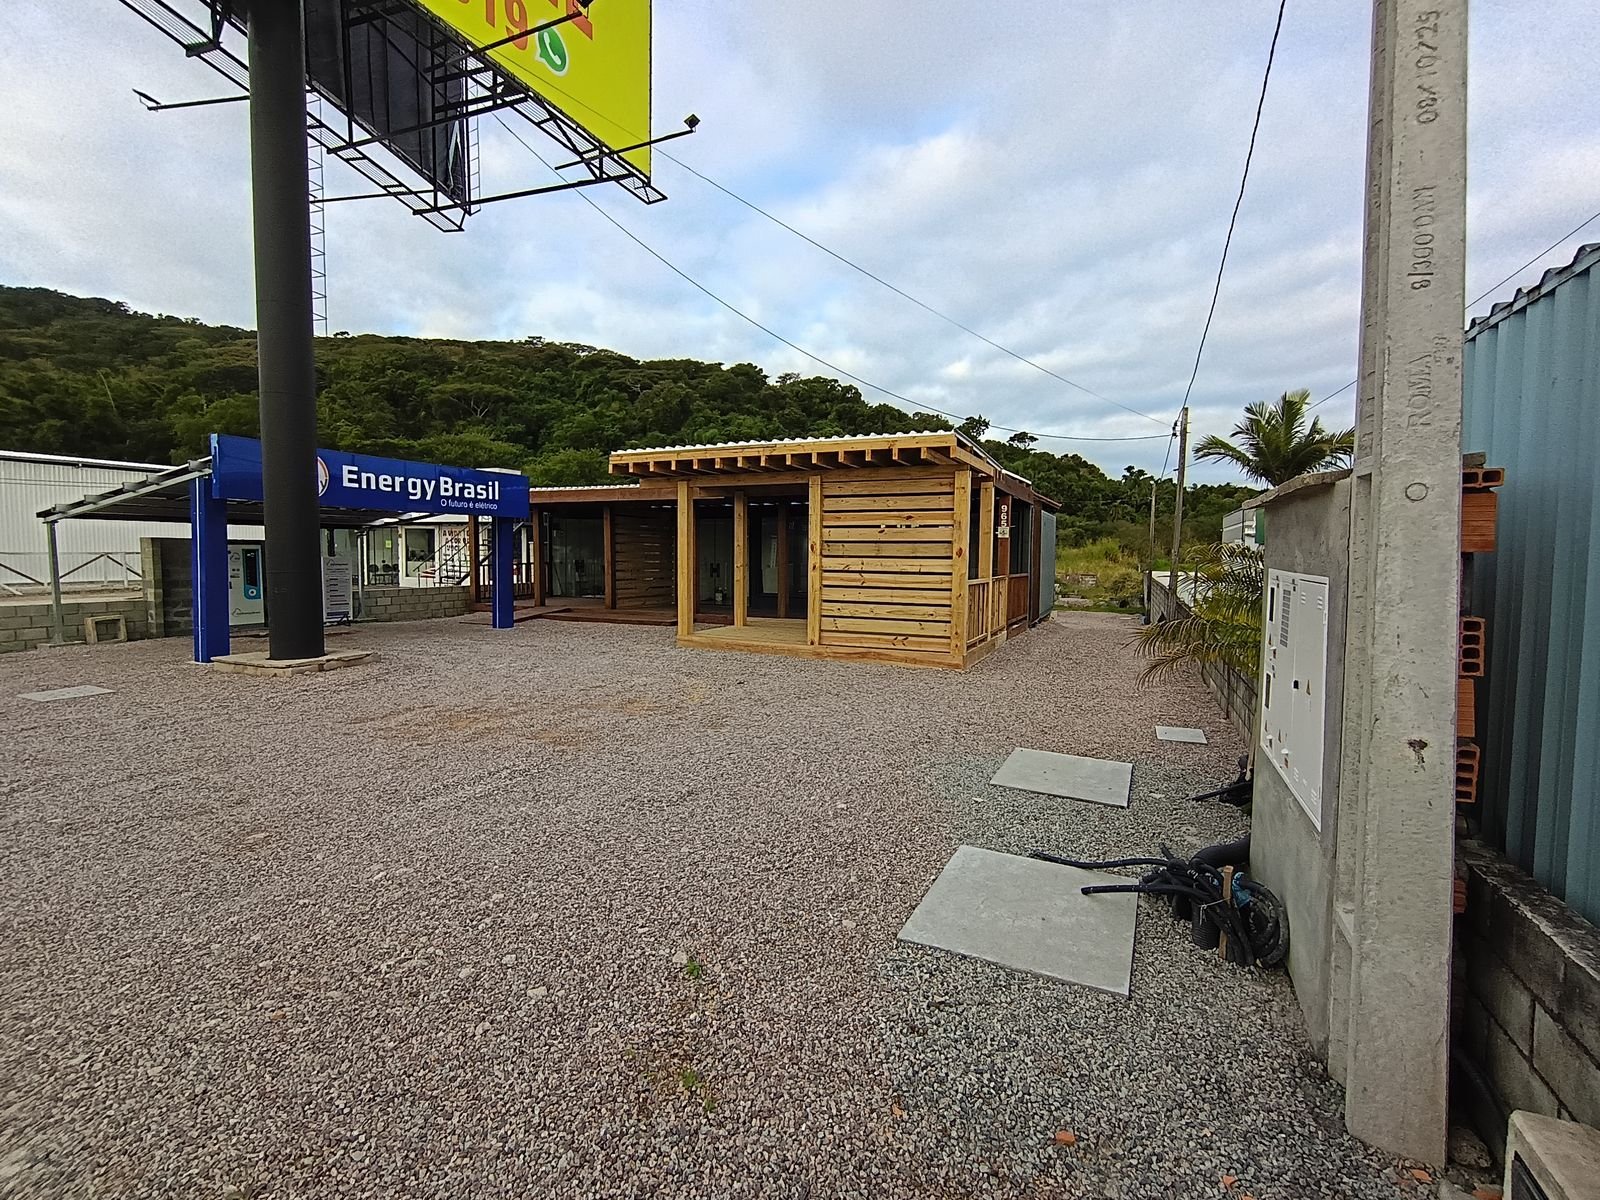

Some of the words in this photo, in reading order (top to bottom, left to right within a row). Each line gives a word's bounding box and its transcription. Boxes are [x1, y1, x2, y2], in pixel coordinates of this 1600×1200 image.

[440, 498, 448, 507] O
[448, 498, 468, 508] futuro
[469, 499, 474, 509] é
[475, 499, 498, 510] elétrico
